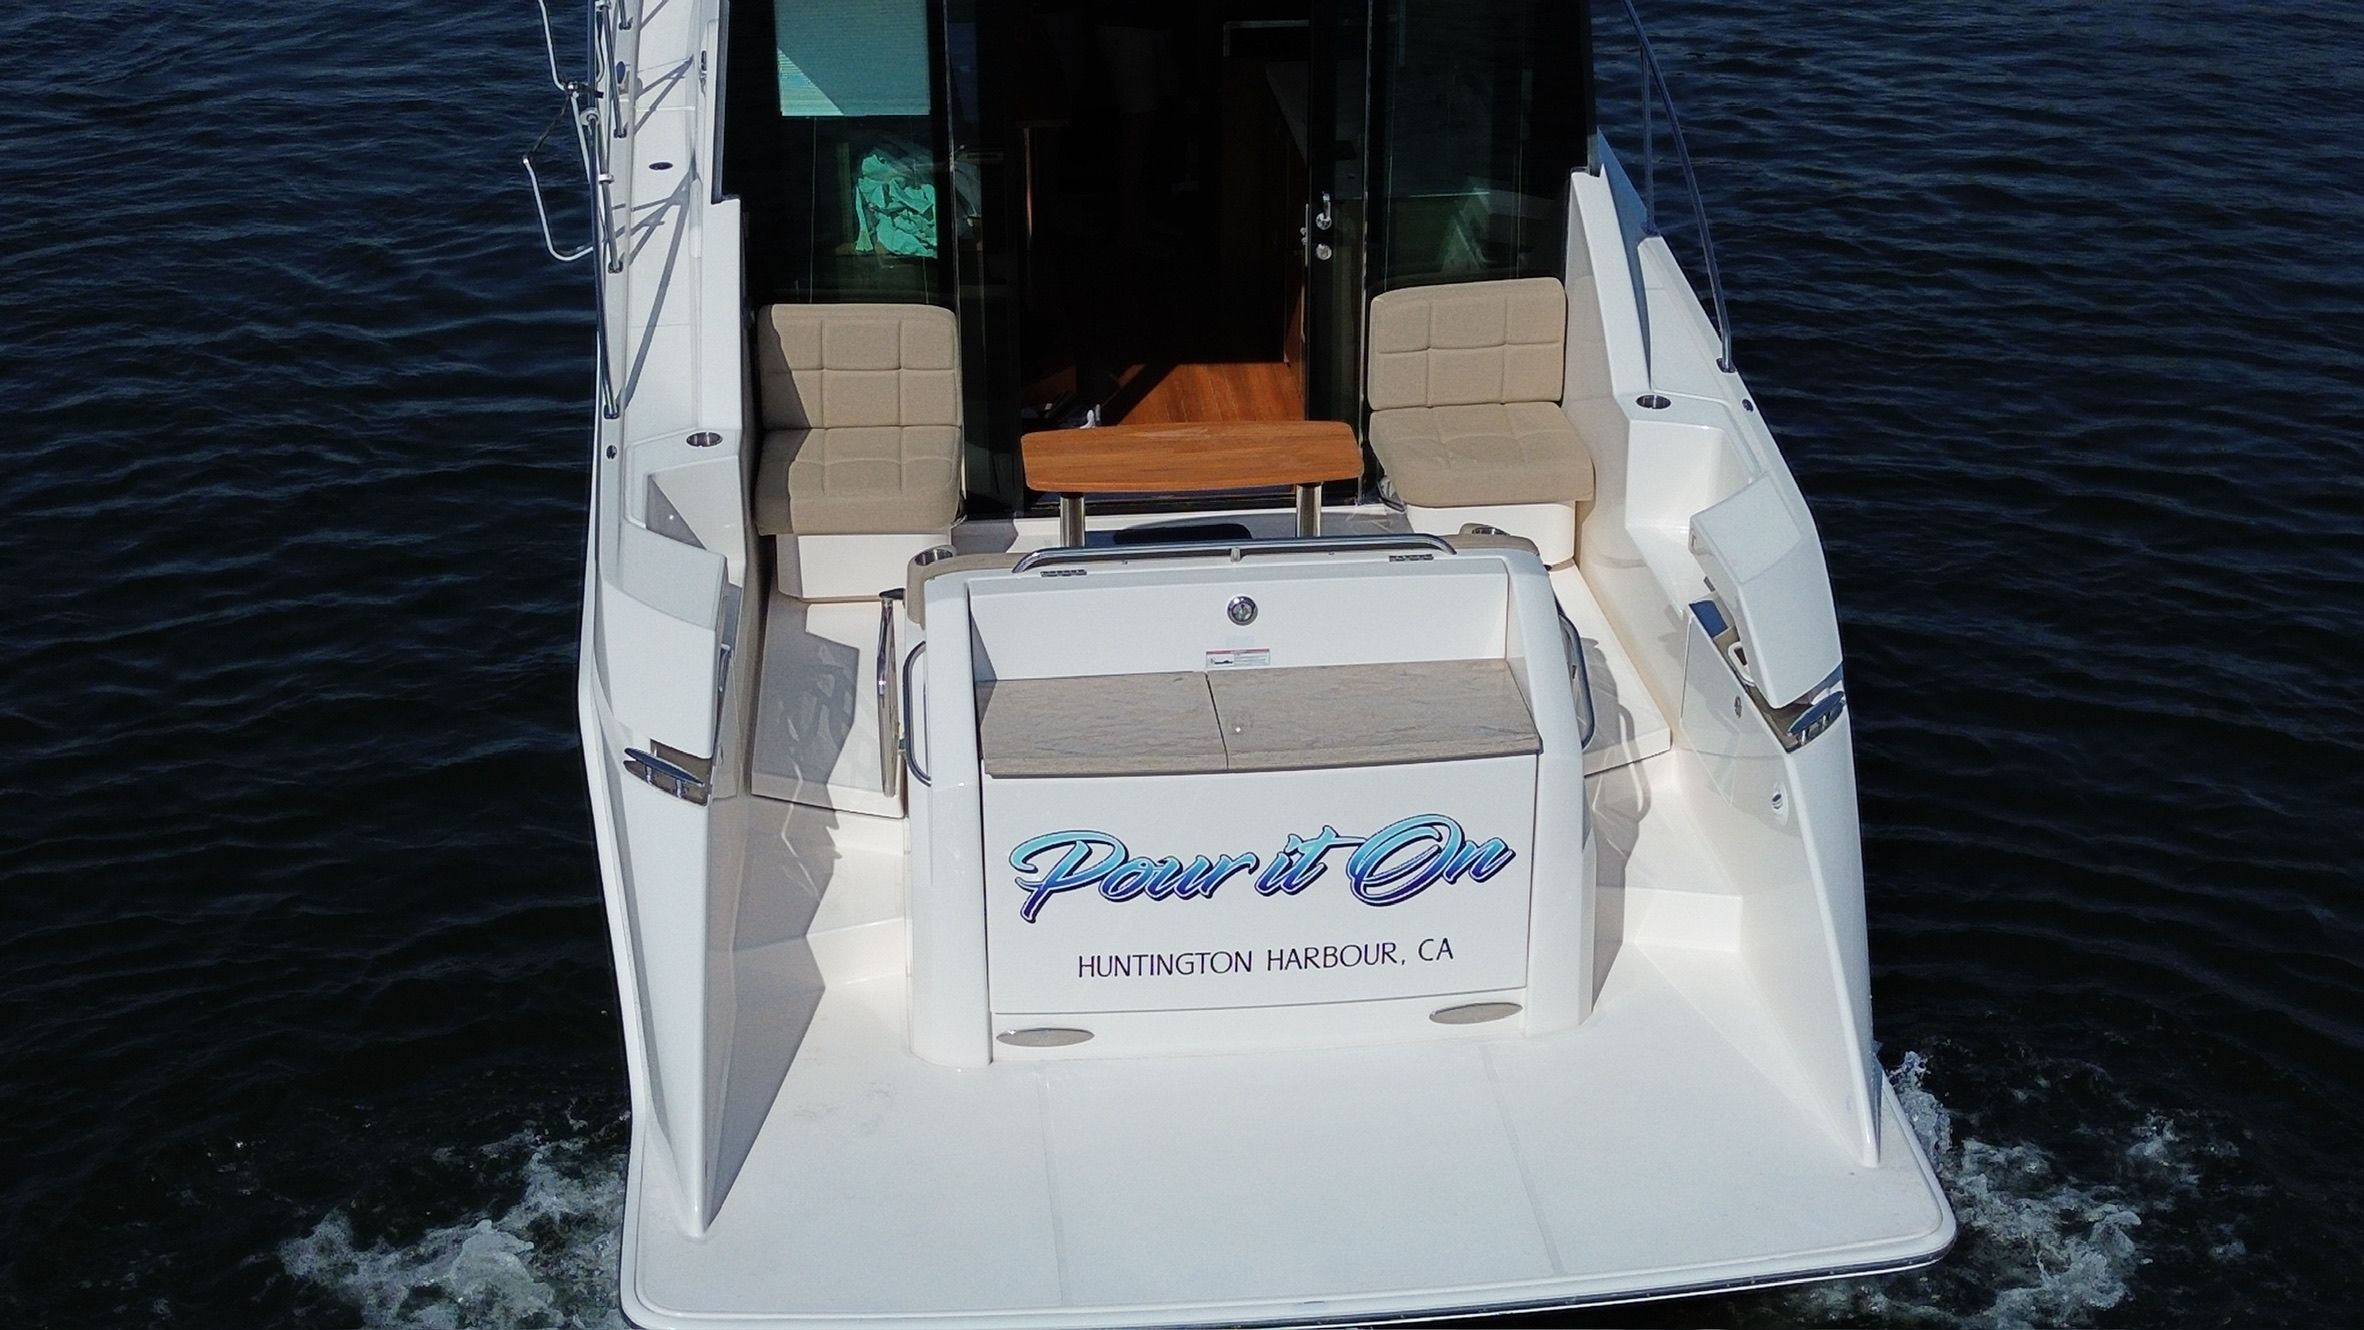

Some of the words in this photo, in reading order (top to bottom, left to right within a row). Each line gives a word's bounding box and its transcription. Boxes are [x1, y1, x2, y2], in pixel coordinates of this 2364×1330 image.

[1008, 828, 1260, 923] Pour
[1254, 824, 1366, 897] it
[1345, 813, 1516, 907] On
[1077, 949, 1253, 979] HUNTINGTON
[1266, 941, 1406, 972] HARBOUR,
[1418, 937, 1454, 962] CA
